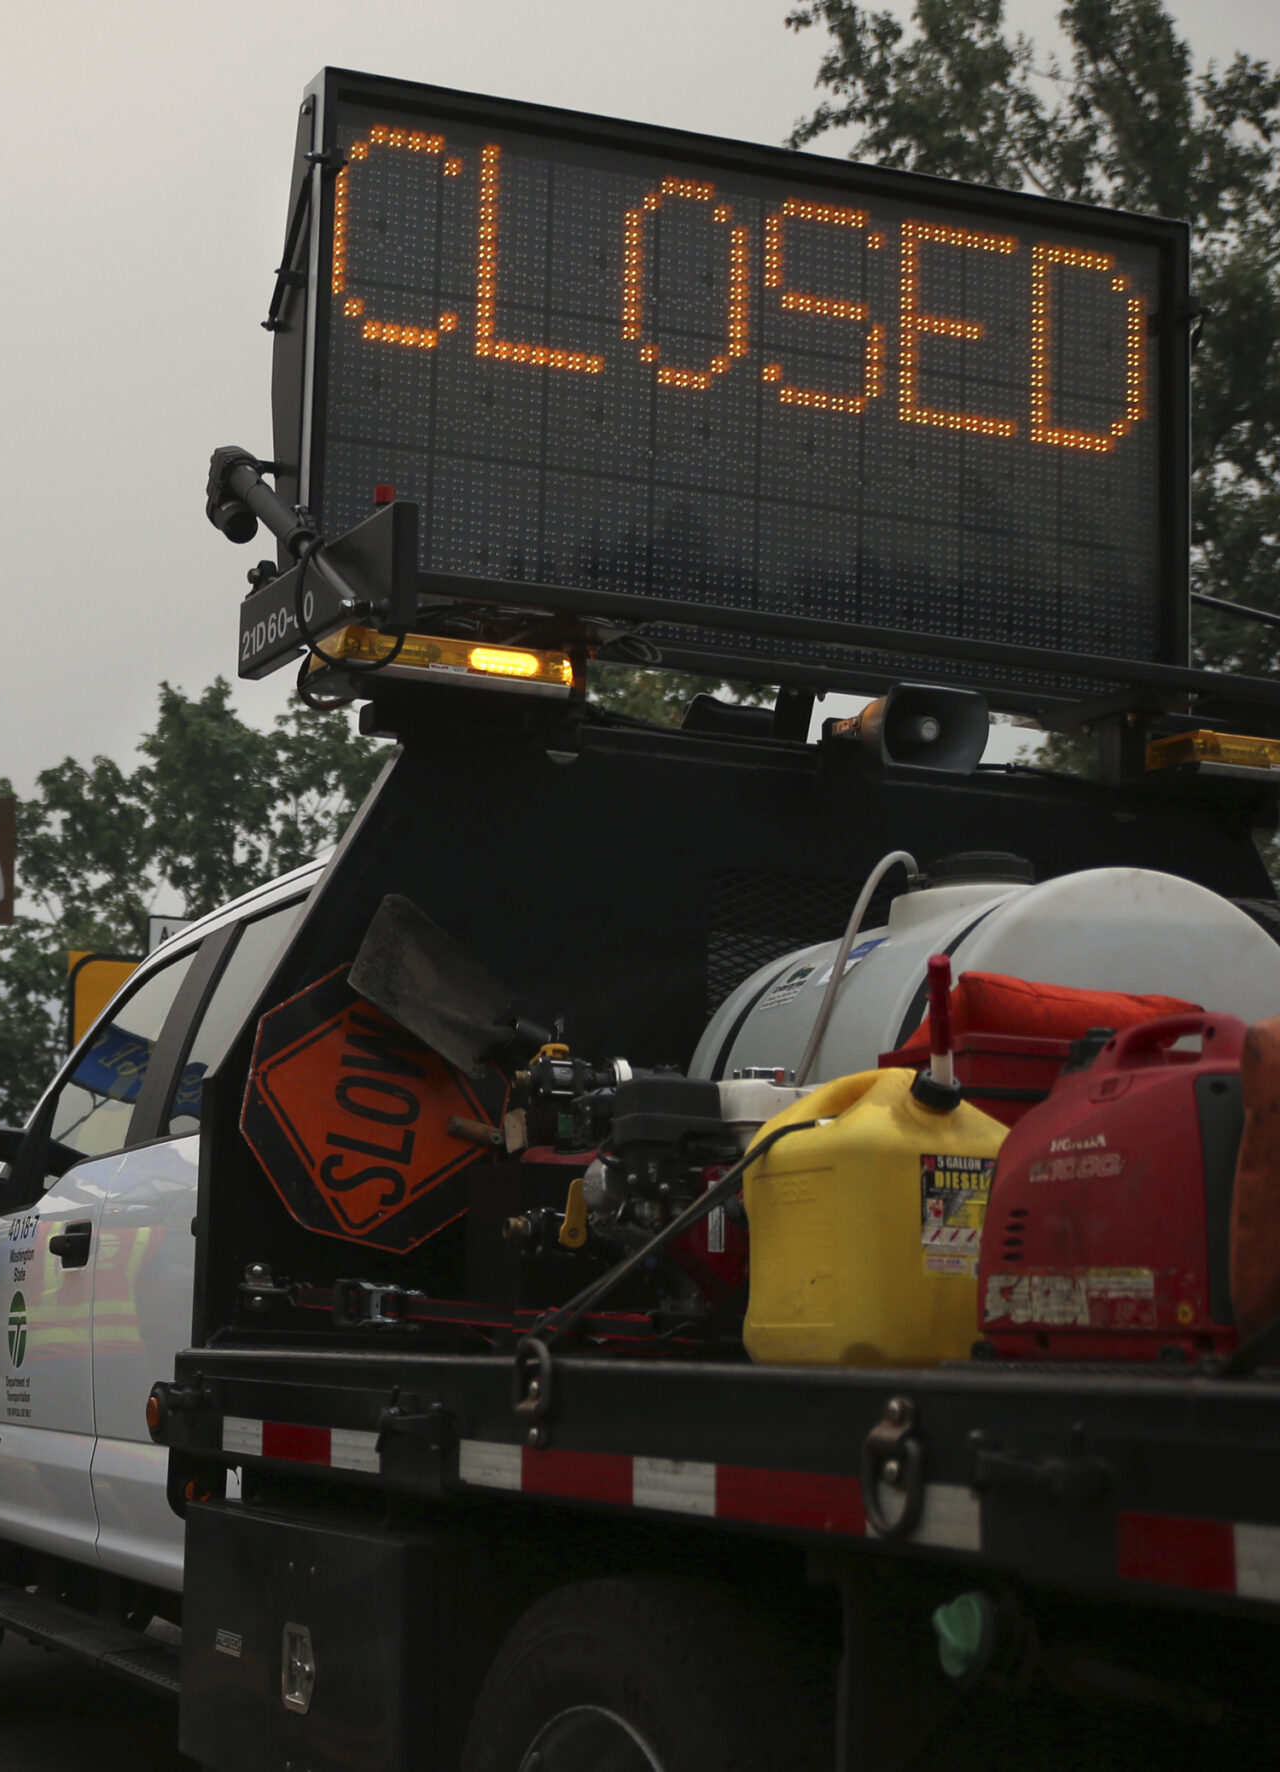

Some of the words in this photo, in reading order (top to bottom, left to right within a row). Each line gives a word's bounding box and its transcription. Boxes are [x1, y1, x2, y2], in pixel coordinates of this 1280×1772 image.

[332, 123, 1148, 453] CLOSED
[241, 590, 314, 661] 21D60-0
[320, 1011, 432, 1207] SLOW
[937, 1156, 944, 1169] 5
[946, 1157, 982, 1170] GALLON
[935, 1170, 985, 1190] DIESEL
[9, 1248, 34, 1264] Washington
[13, 1267, 26, 1282] State
